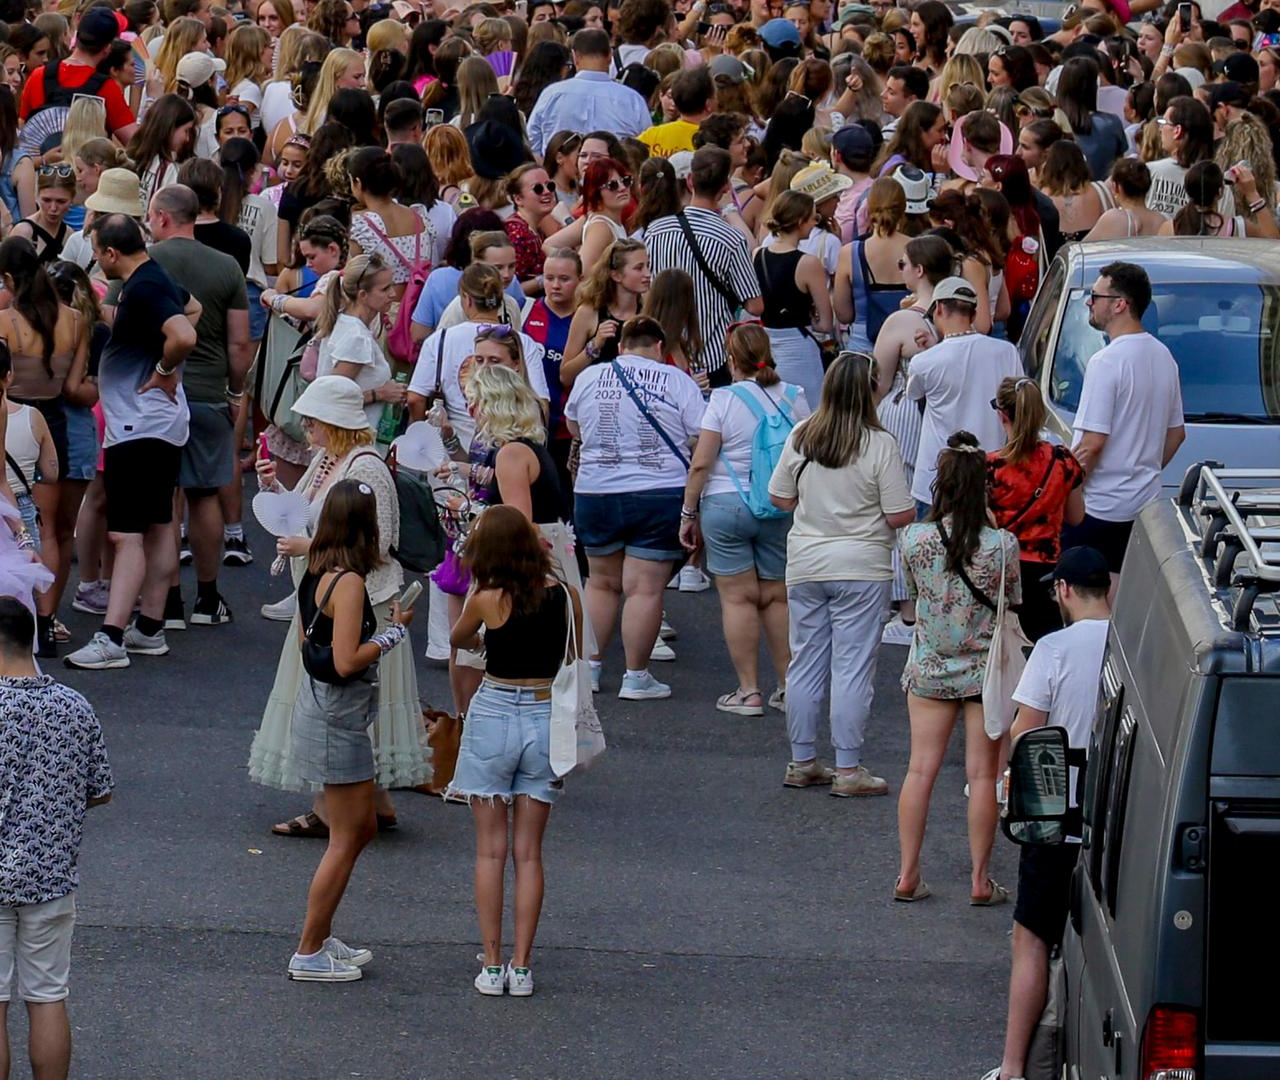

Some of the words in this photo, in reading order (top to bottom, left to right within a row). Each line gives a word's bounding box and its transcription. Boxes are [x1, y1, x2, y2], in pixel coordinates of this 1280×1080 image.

[1152, 202, 1175, 214] 2023
[637, 367, 671, 385] SWIFT
[595, 389, 622, 400] 2023
